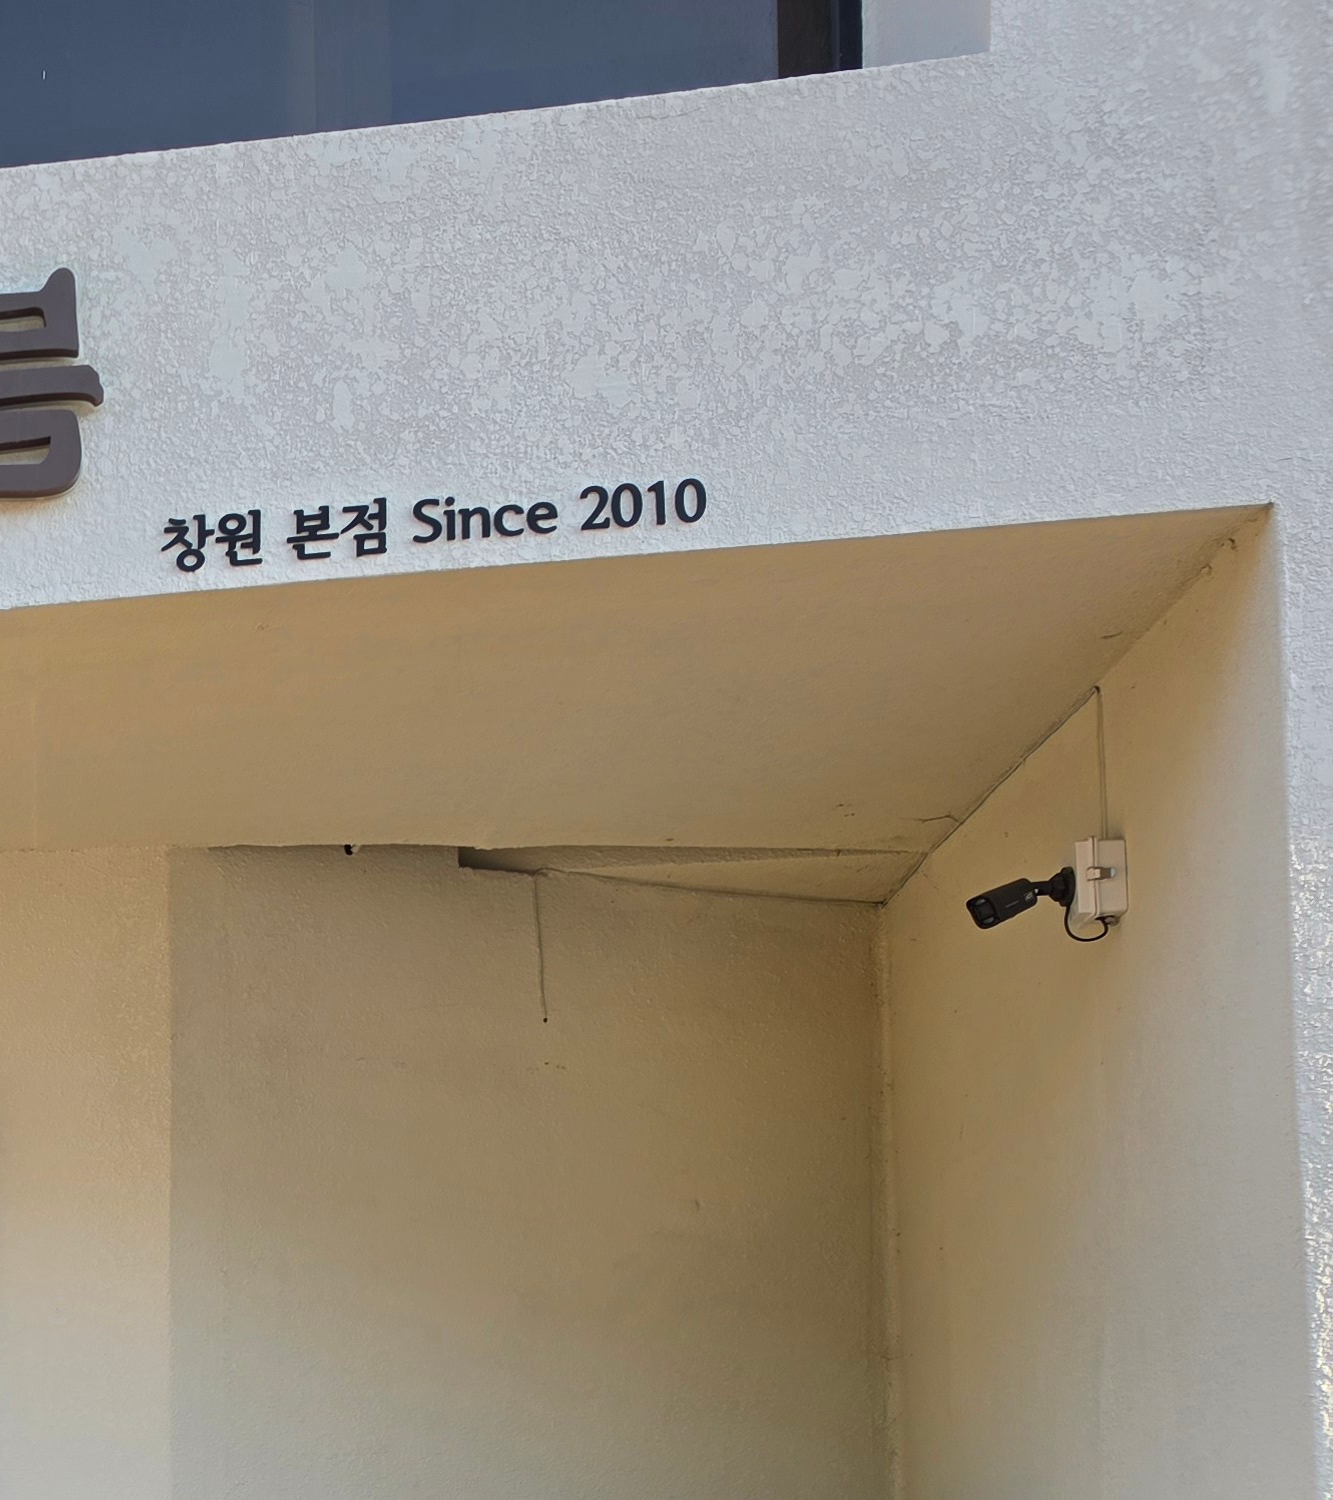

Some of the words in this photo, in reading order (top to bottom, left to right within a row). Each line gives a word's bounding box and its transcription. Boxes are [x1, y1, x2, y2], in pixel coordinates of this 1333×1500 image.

[160, 508, 263, 573] 창원
[286, 497, 388, 560] 본점
[412, 496, 559, 544] Since
[579, 477, 708, 532] 2010
